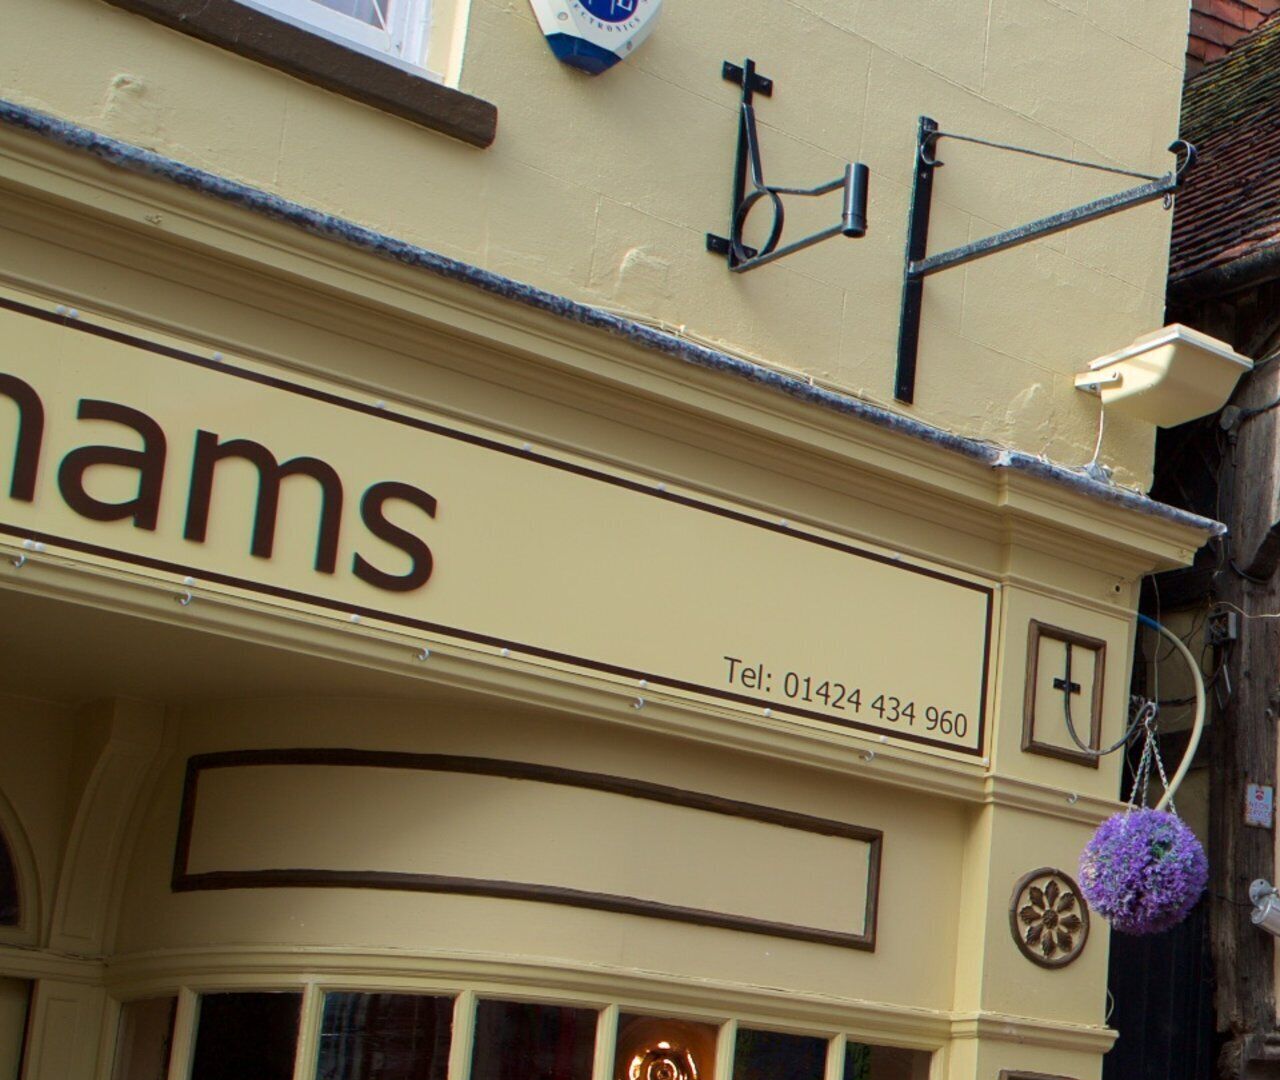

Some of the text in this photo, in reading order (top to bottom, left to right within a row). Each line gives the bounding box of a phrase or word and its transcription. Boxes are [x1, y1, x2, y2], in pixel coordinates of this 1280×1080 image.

[723, 656, 968, 738] Tel: 01424 434 960
